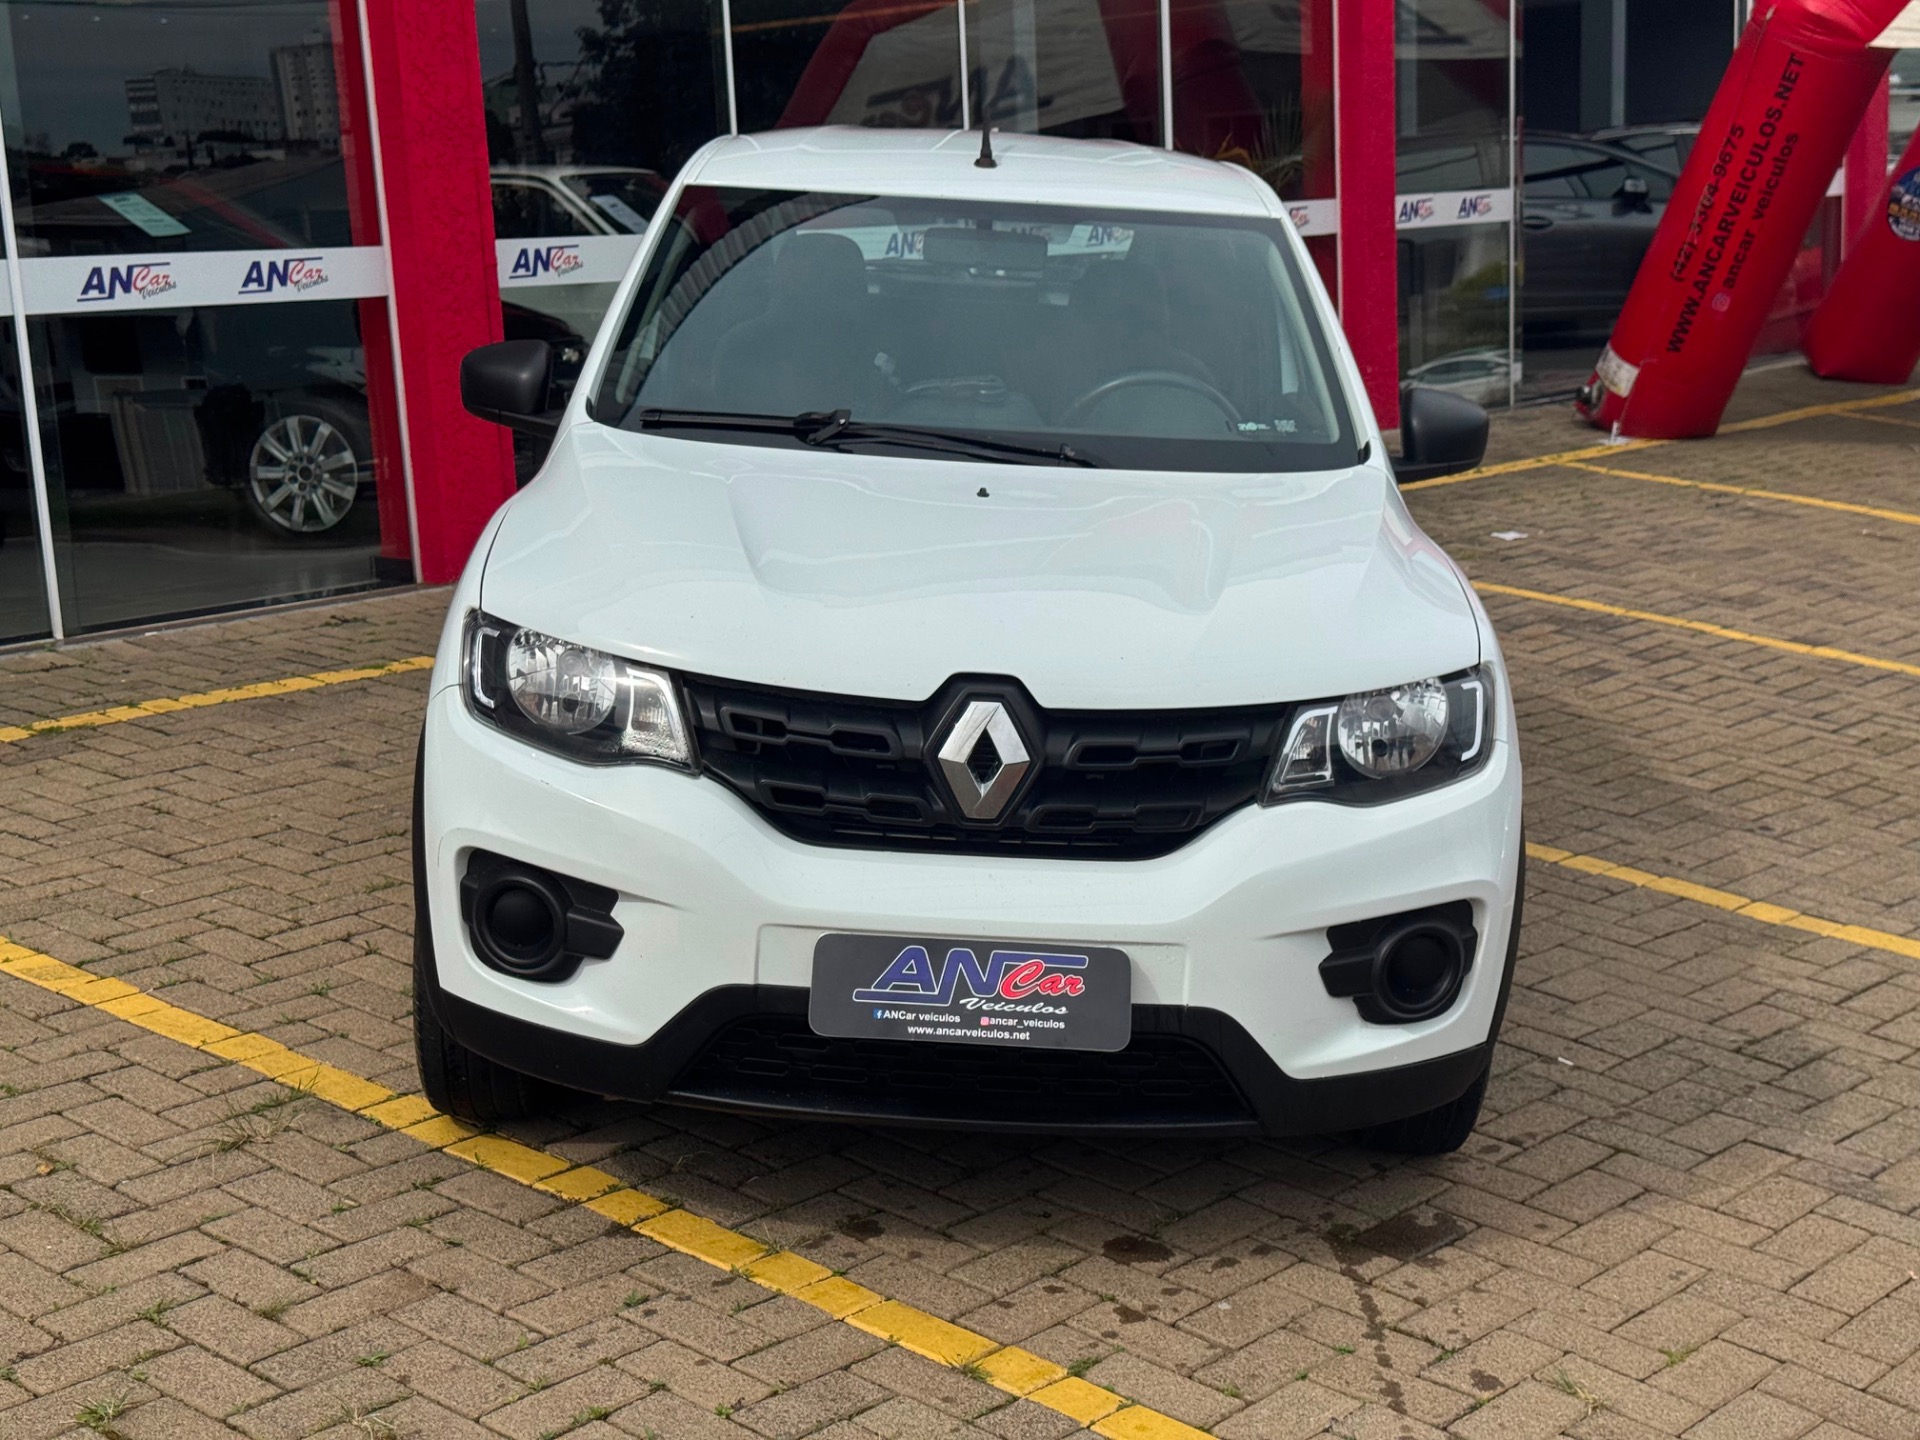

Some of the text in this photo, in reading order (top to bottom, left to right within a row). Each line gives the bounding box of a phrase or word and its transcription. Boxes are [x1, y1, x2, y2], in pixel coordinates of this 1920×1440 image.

[1666, 54, 1804, 353] WWW.ANCARVEICULOS.NET
[883, 1009, 917, 1021] ANCar
[989, 1017, 1066, 1029] ancar_veiculos
[907, 1025, 1031, 1041] www.ancarveiculos.net
